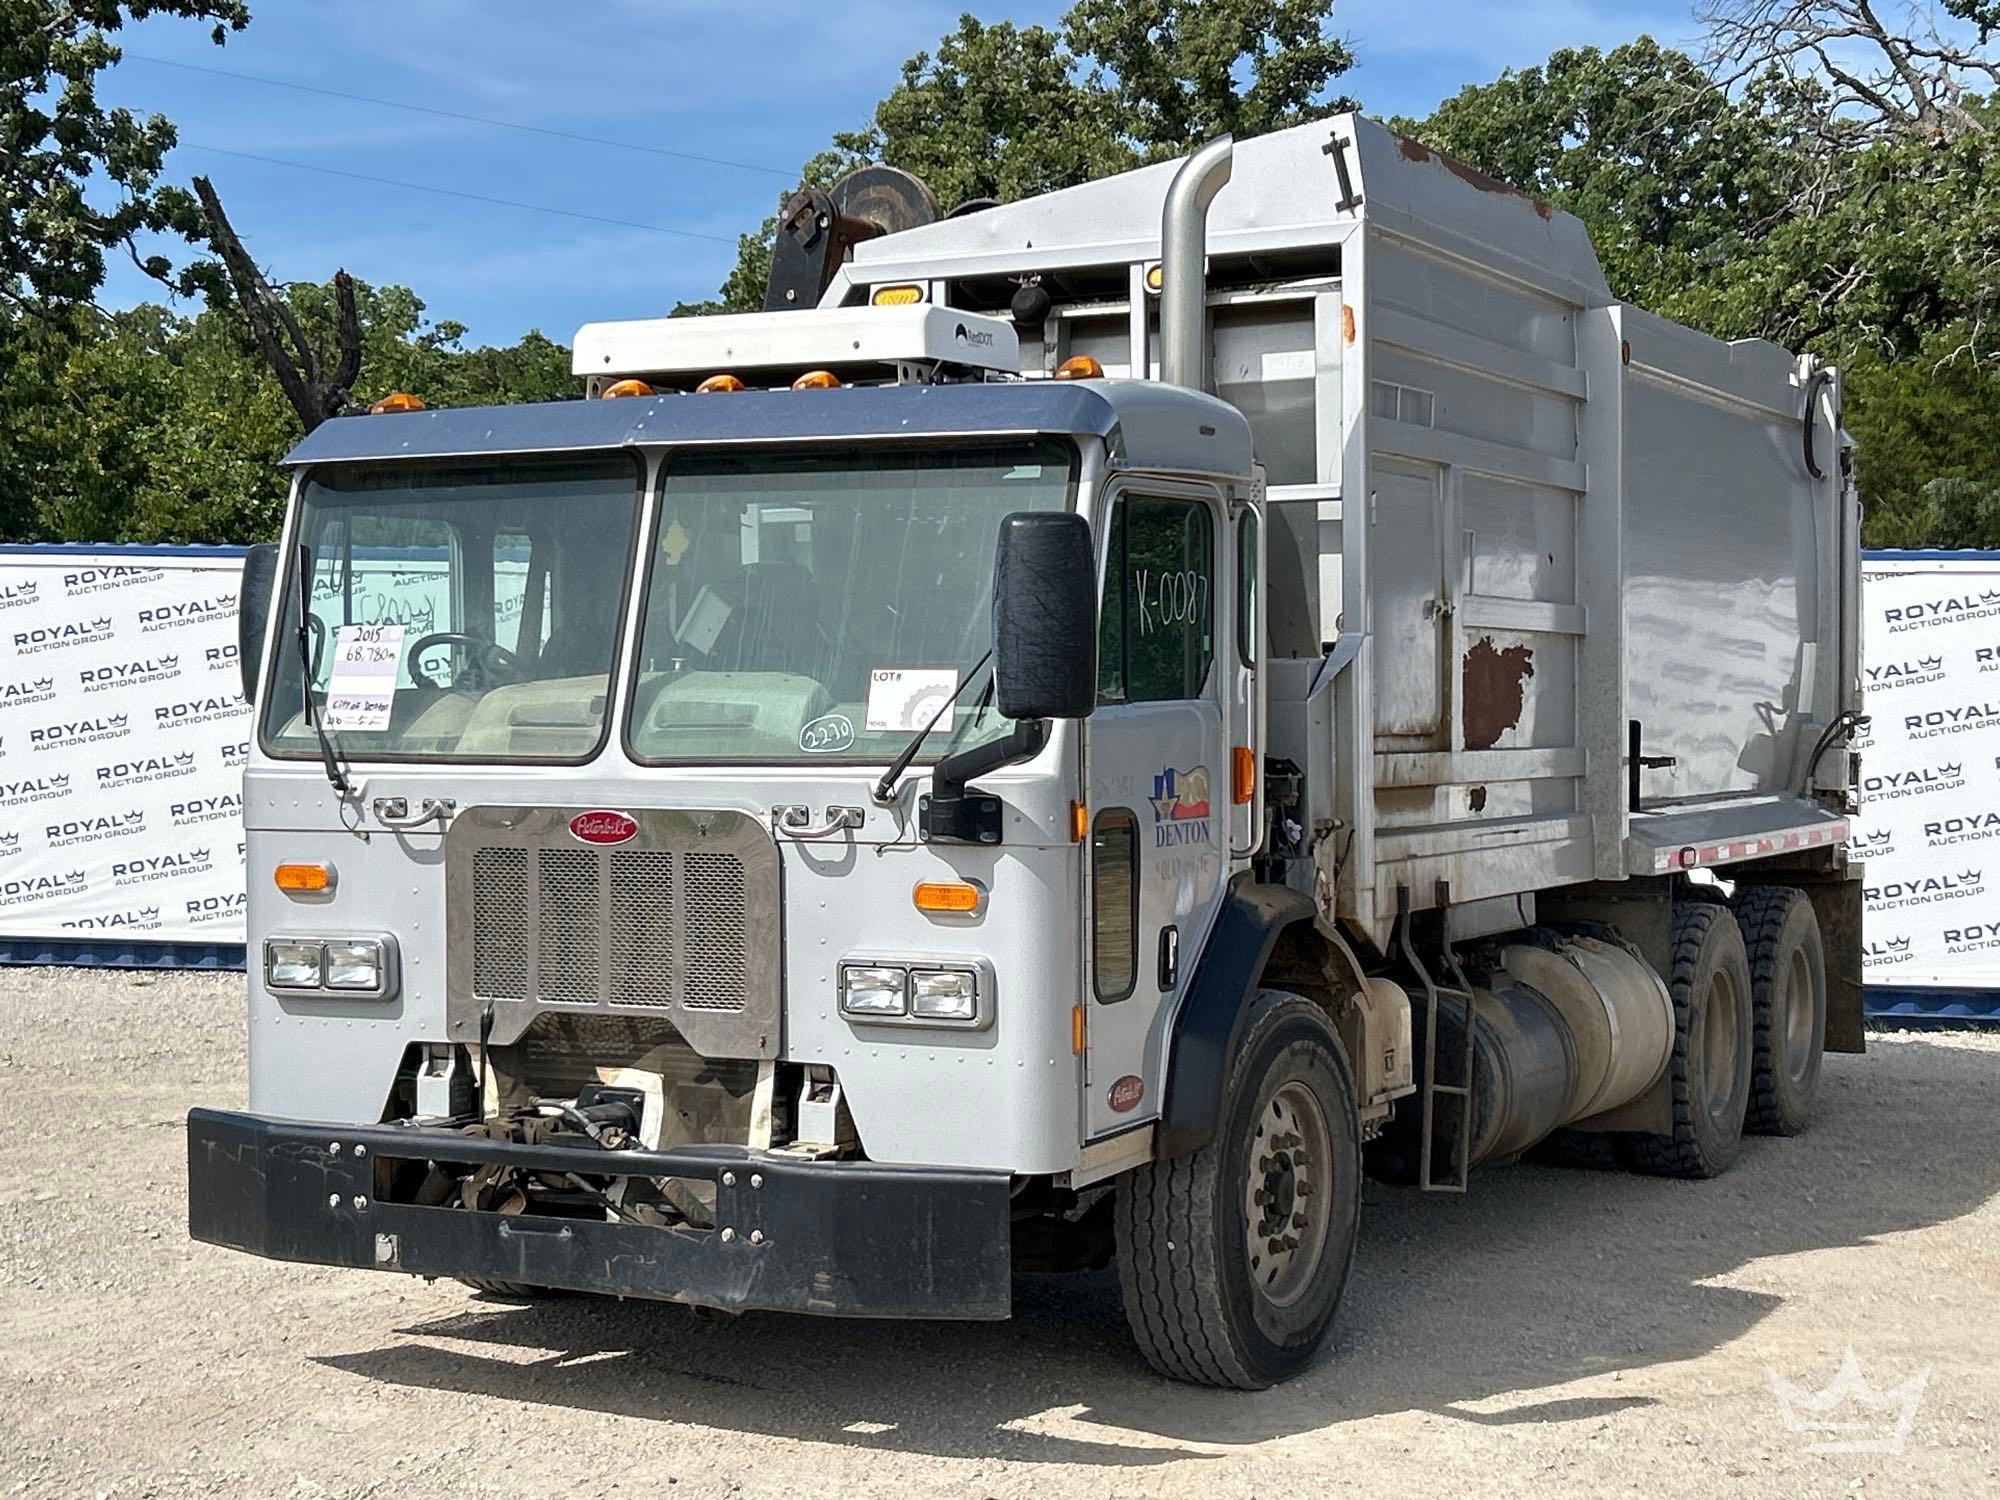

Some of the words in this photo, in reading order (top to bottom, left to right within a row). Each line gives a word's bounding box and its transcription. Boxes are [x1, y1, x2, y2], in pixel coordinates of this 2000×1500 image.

[64, 567, 142, 587] ROYAL
[67, 581, 121, 597] AUCTION
[122, 573, 165, 586] GROUP
[138, 599, 217, 624] ROYAL
[1135, 569, 1208, 637] K-0087
[1885, 596, 1980, 623] ROYAL
[141, 617, 196, 633] AUCTION
[197, 609, 240, 623] GROUP
[1889, 616, 1954, 634] AUCTION
[1955, 607, 2000, 622] GROU
[13, 622, 92, 646] ROYAL
[17, 640, 71, 656] AUCTION
[72, 632, 115, 646] GROUP
[352, 626, 385, 643] 2015
[80, 660, 159, 684] ROYAL
[208, 659, 240, 671] AUCT
[1865, 662, 1919, 680] YAL
[83, 678, 137, 693] AUCTION
[139, 669, 182, 684] GROUP
[1895, 672, 1946, 688] GROUP
[14, 692, 56, 706] GROUP
[155, 697, 233, 720] ROYAL
[158, 714, 212, 730] AUCTION
[1904, 703, 2000, 730] ROYAL
[30, 719, 108, 742] ROYAL
[33, 736, 87, 752] AUCTION
[88, 728, 131, 742] GROUP
[1908, 723, 1974, 740] AUCTION
[96, 757, 174, 780] ROYAL
[99, 774, 153, 790] AUCTION
[154, 766, 197, 780] GROUP
[1864, 768, 1938, 791] OYAL
[0, 778, 50, 798] YAL
[0, 797, 28, 807] TION
[30, 788, 73, 802] GROUP
[1860, 788, 1912, 804] UCTION
[1914, 779, 1965, 795] GROUP
[46, 815, 124, 839] ROYAL
[173, 811, 227, 827] AUCTION
[576, 816, 632, 836] Peterbilt
[1924, 812, 2000, 837] ROYA
[49, 833, 102, 848] AUCTION
[104, 825, 147, 838] GROUP
[1155, 820, 1210, 848] DENTON
[1928, 830, 1993, 847] AUCTION
[0, 847, 22, 857] OUP
[112, 853, 190, 876] ROYAL
[115, 871, 169, 886] AUCTION
[170, 864, 213, 877] GROUP
[0, 875, 66, 896] OYAL
[0, 892, 44, 906] UCTION
[46, 885, 89, 898] GROUP
[1863, 875, 1958, 901] ROYAL
[186, 892, 247, 914] ROYA
[1866, 895, 1932, 912] AUCTION
[1933, 886, 1985, 902] GROUP
[125, 921, 162, 931] OUP
[189, 908, 243, 923] AUCTION
[1943, 922, 2000, 943] ROY
[1946, 939, 2000, 954] AUCTIO
[1862, 953, 1914, 967] GROUP
